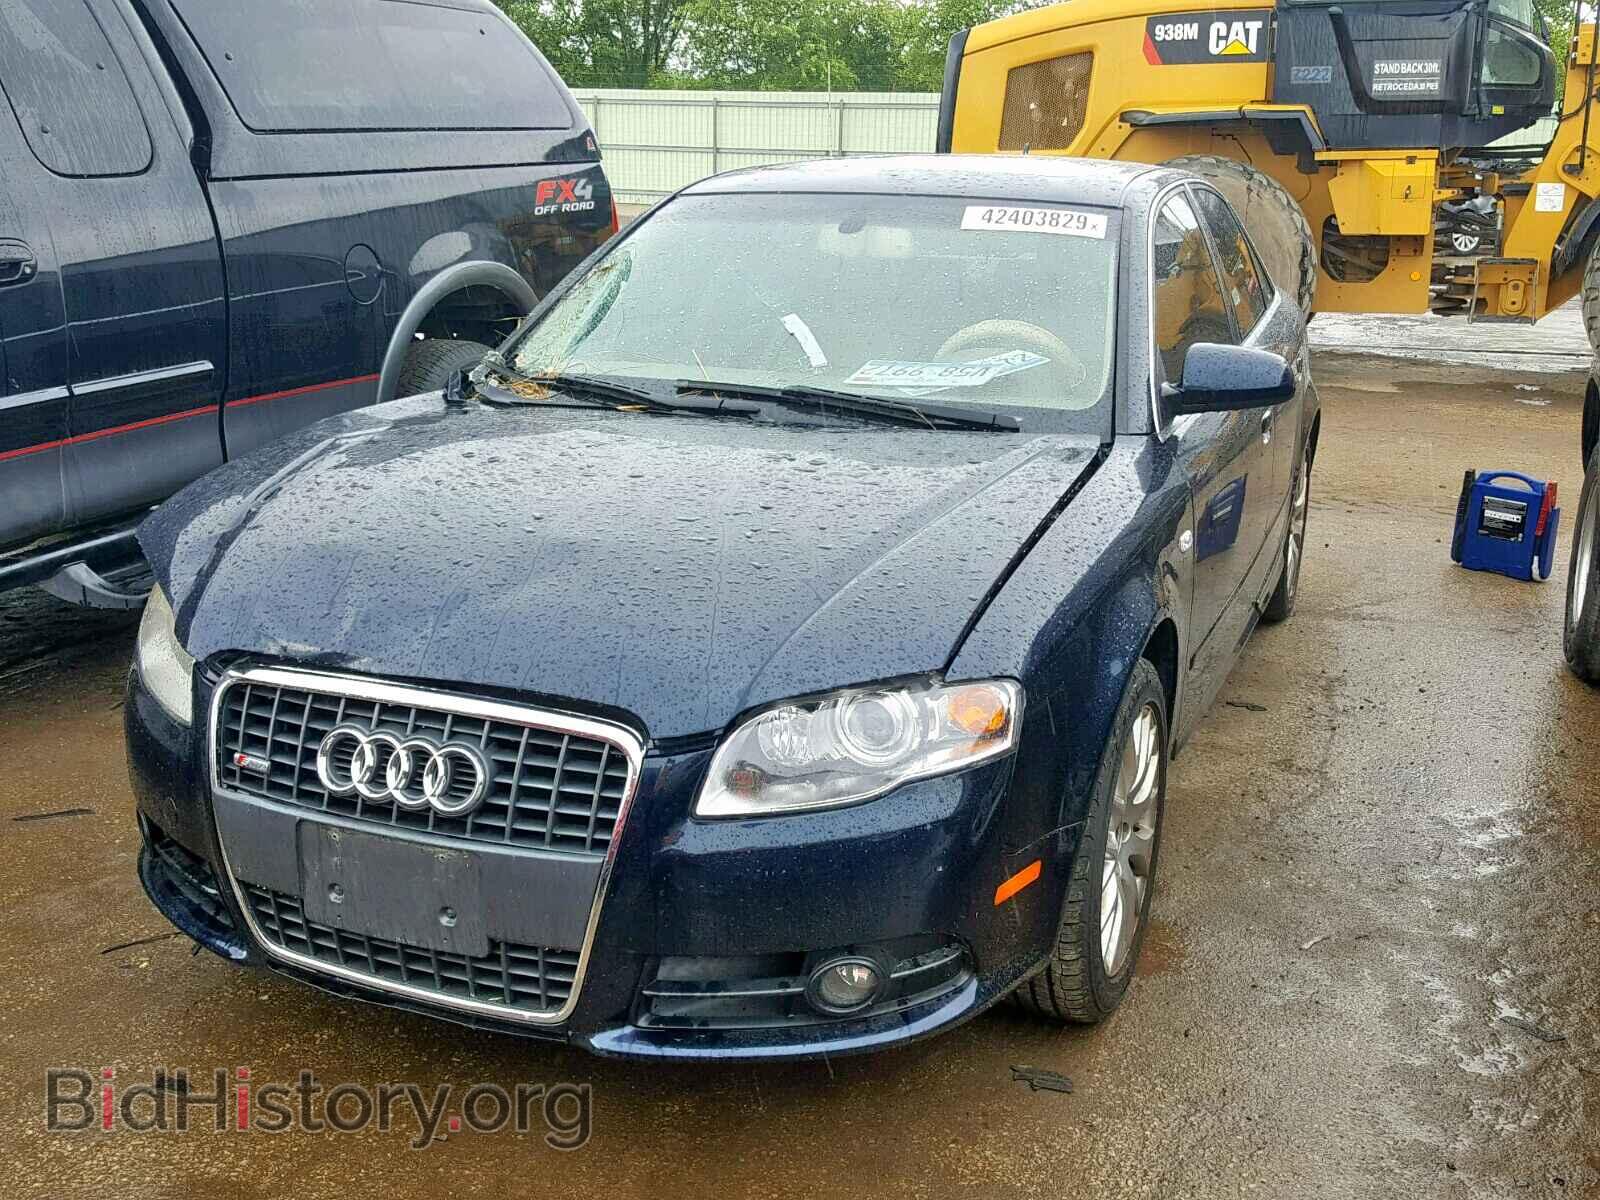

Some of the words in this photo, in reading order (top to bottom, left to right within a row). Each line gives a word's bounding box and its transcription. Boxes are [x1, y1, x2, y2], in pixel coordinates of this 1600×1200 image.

[1155, 22, 1199, 41] 938M
[1208, 21, 1262, 55] CAT
[1374, 63, 1400, 74] STAND
[1401, 63, 1424, 73] BACK
[536, 178, 593, 205] FX4
[534, 204, 558, 215] OFF
[562, 201, 595, 213] ROAD
